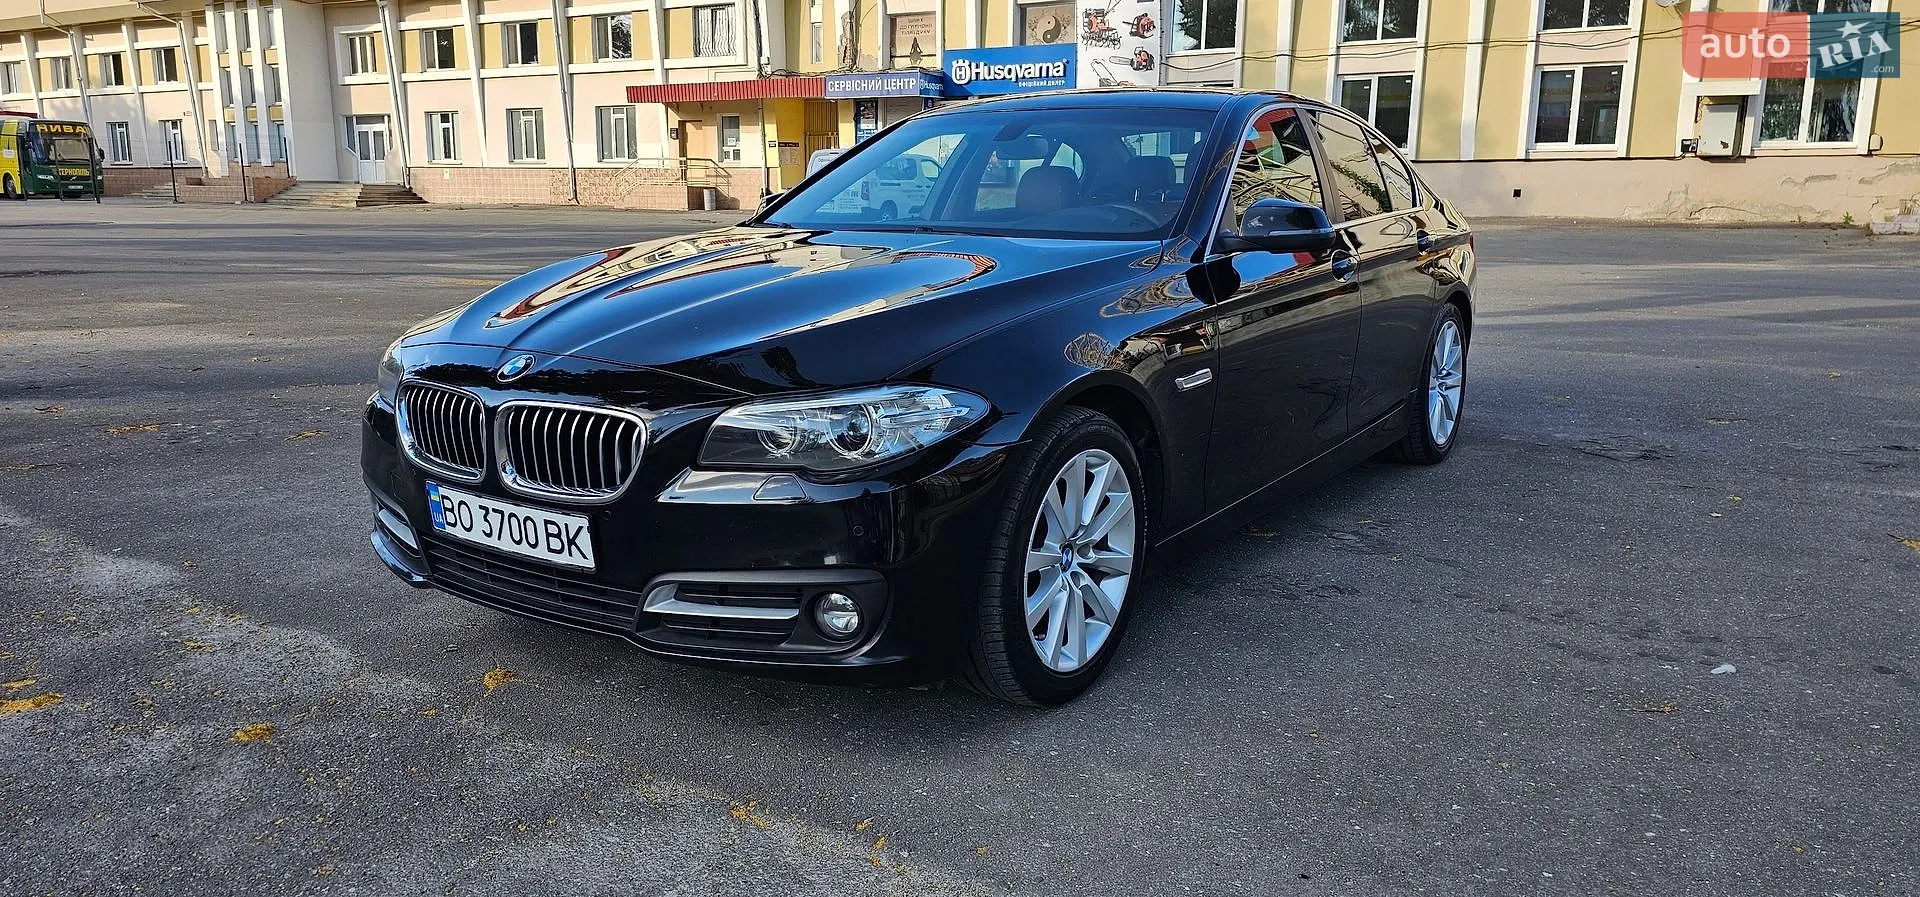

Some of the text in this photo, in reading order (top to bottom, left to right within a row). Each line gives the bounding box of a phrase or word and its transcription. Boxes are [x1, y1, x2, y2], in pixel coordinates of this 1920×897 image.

[971, 61, 1065, 82] Husqvarna
[828, 76, 917, 92] СЕРВІСНИЙ ЦЕНТР
[36, 123, 88, 133] НИВА
[434, 511, 444, 523] UA
[440, 494, 589, 560] BO 3700 BK
